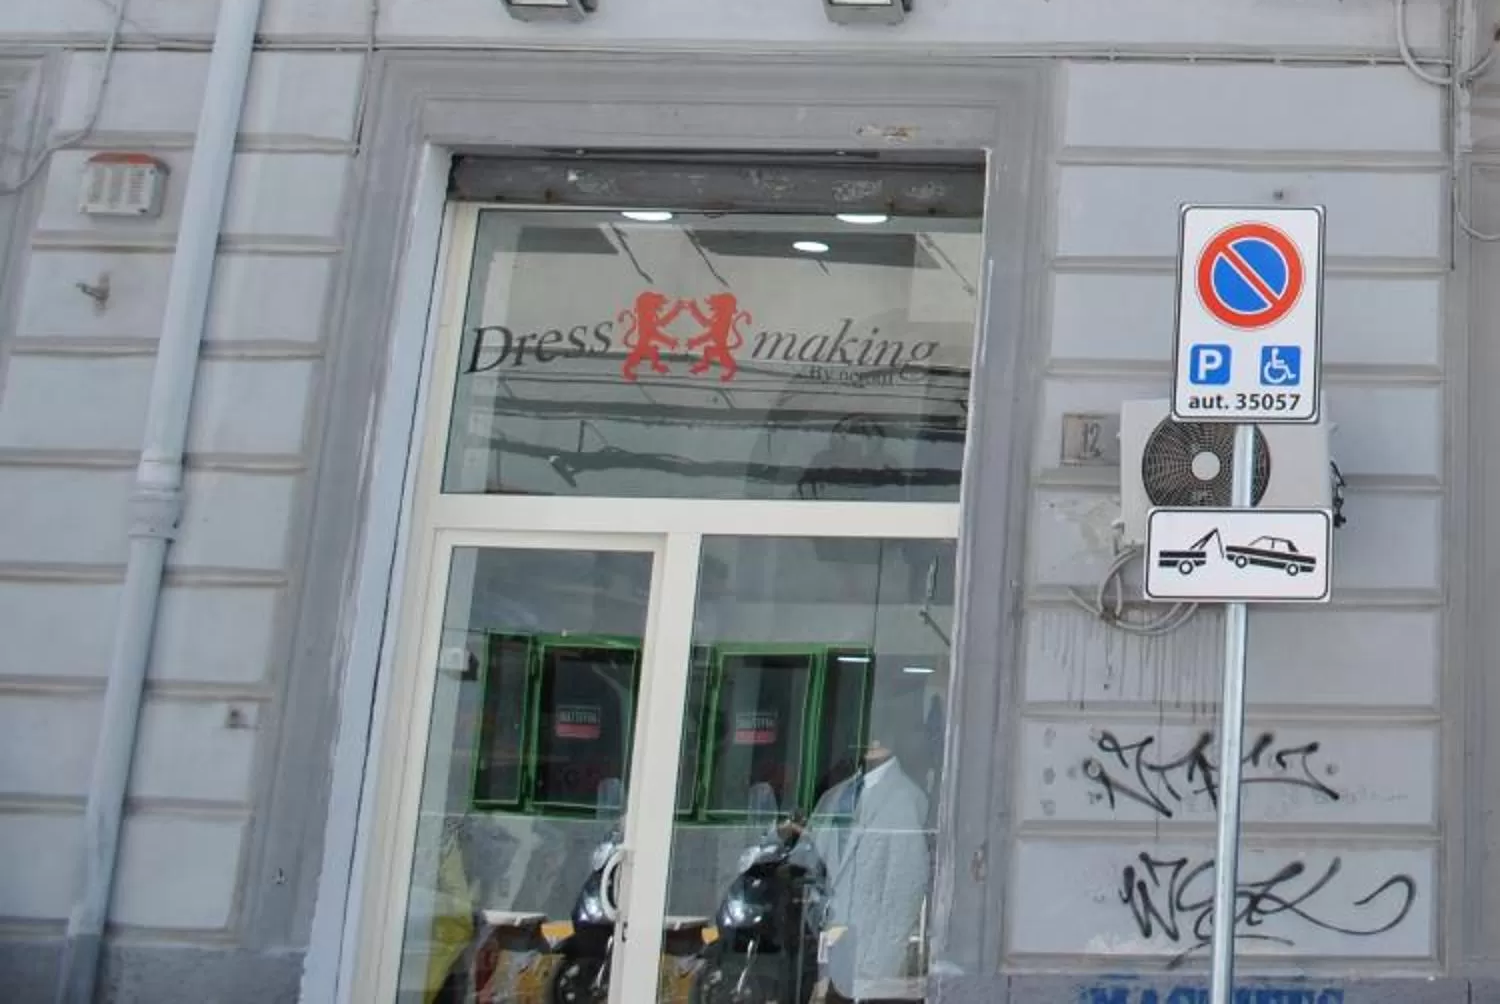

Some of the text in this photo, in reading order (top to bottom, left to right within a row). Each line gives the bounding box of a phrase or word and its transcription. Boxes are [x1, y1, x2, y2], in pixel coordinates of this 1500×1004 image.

[463, 318, 940, 380] Dress making
[1199, 348, 1224, 380] P
[1188, 393, 1301, 412] aut. 35057
